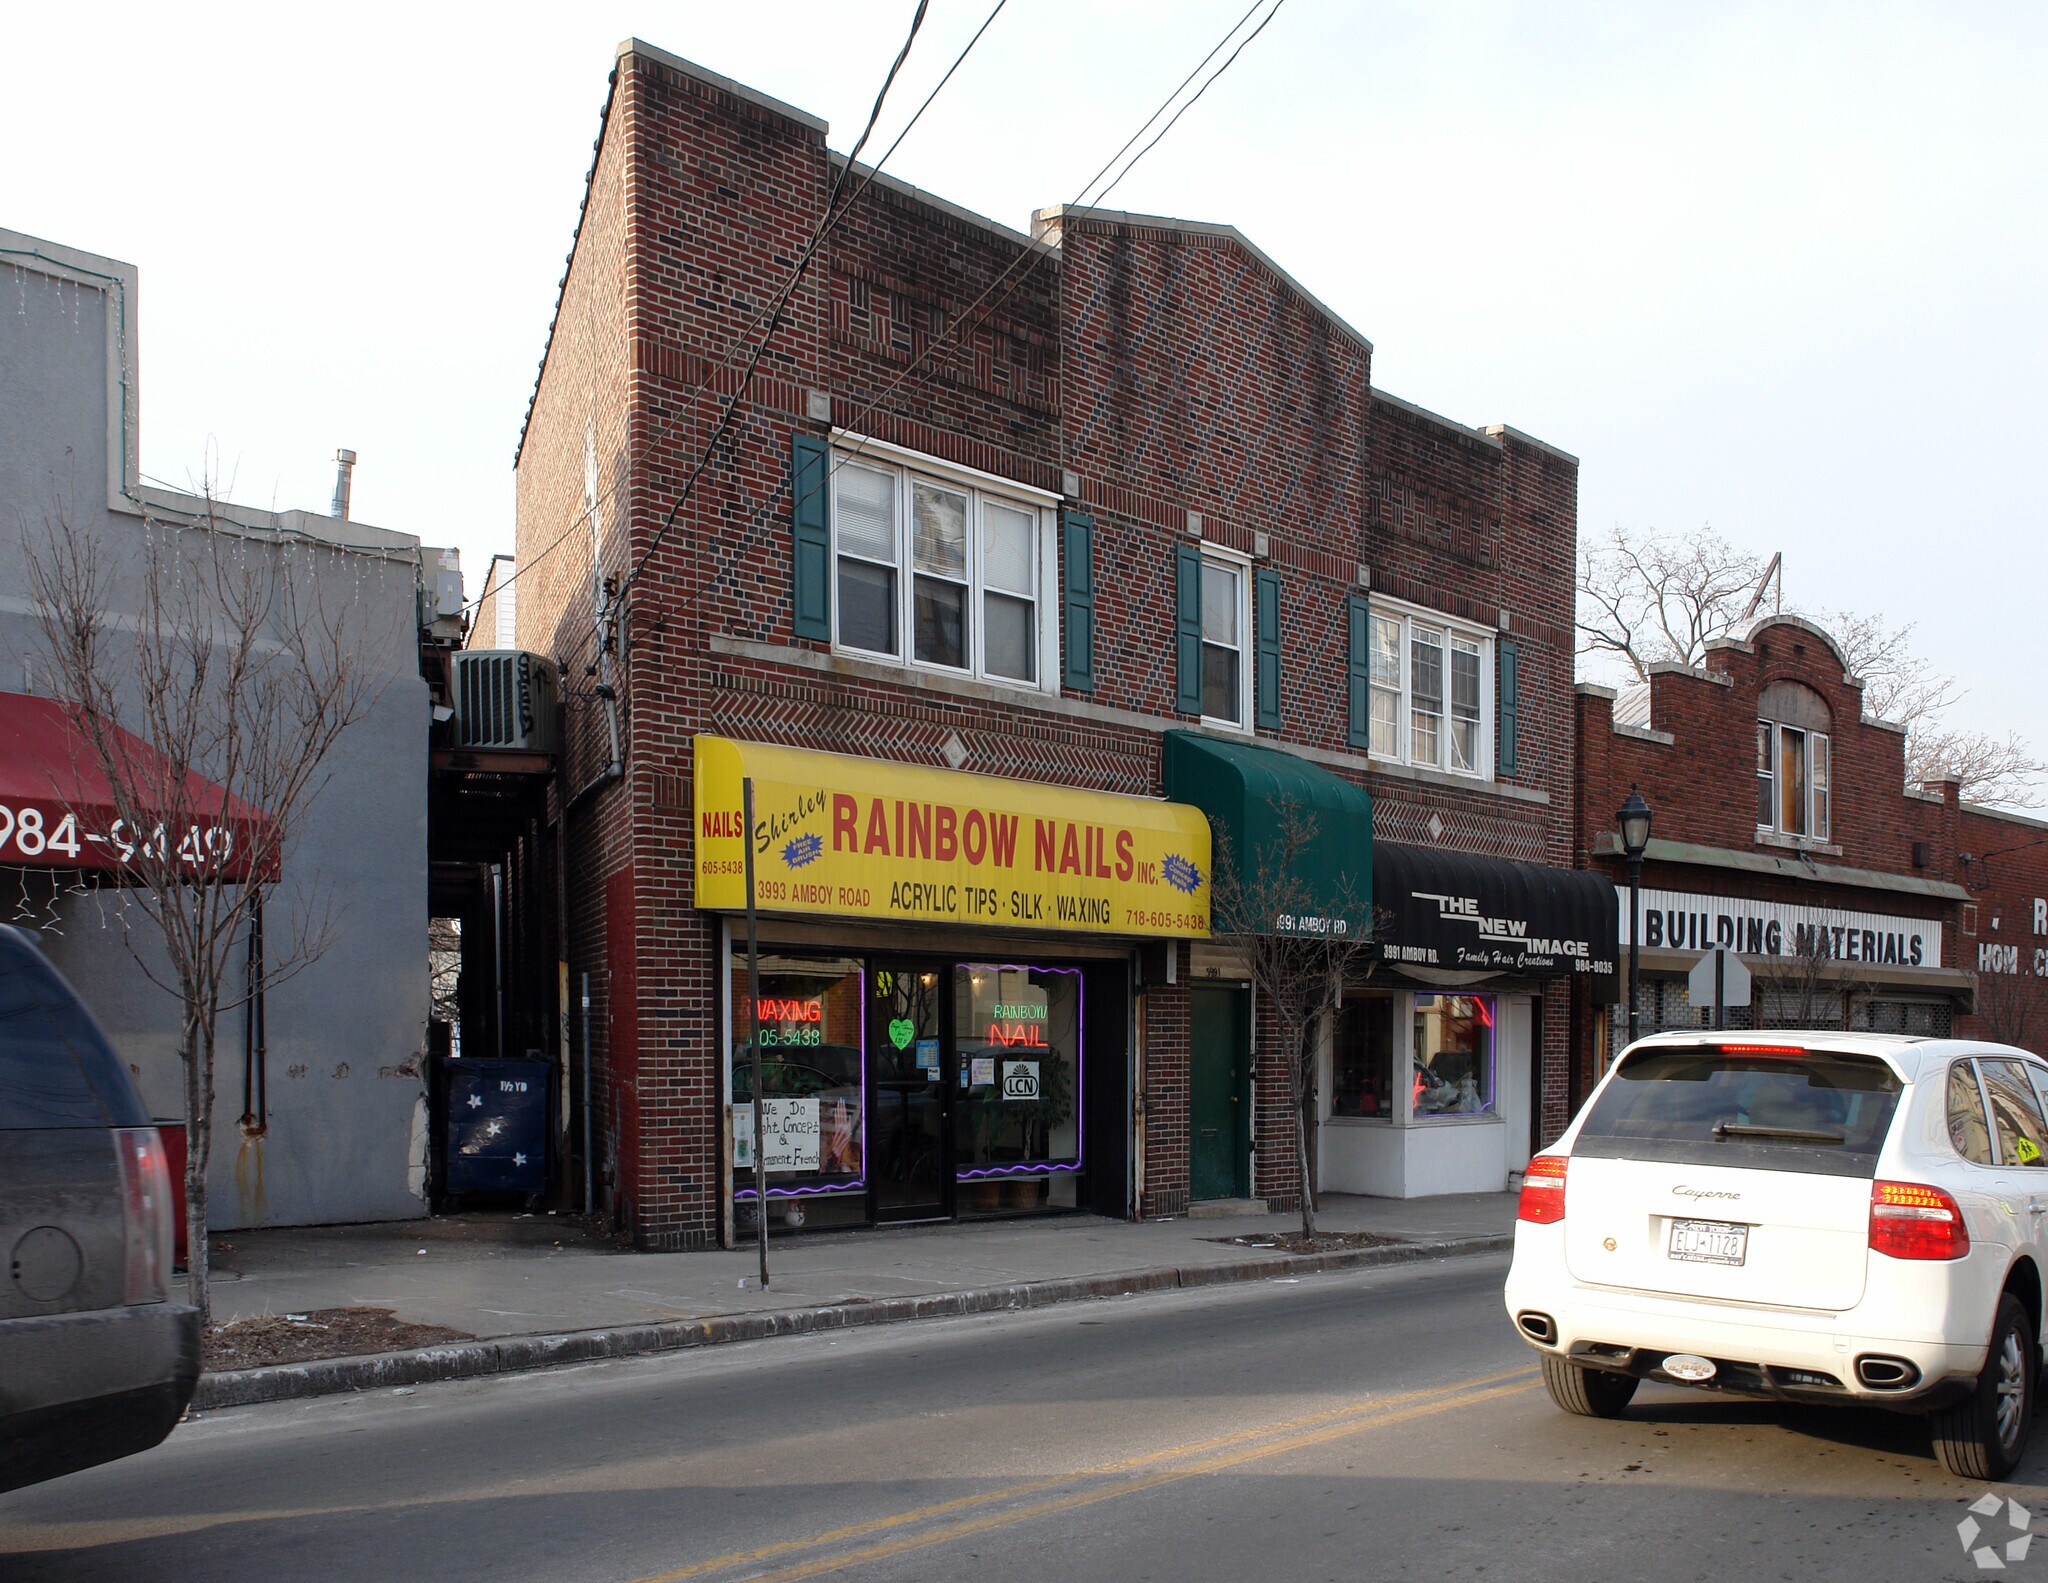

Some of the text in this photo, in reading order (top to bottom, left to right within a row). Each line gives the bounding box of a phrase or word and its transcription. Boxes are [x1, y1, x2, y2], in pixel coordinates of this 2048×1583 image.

[702, 811, 743, 838] NAILS
[755, 789, 826, 853] Shirley
[792, 839, 812, 849] FREE
[833, 793, 1158, 885] RAINBOW NAILS INC.
[798, 846, 810, 854] AIR
[702, 861, 743, 874] 605-5438
[1173, 860, 1191, 873] LIGHT
[758, 880, 870, 907] 3993 AMBOY ROAD
[890, 881, 1110, 924] ACRYLIC TIPS SILK WAXING
[1430, 893, 1479, 915] THE
[1126, 910, 1204, 930] 718-605-5438
[1299, 916, 1330, 933] AMBOY
[1475, 916, 1527, 937] NEW
[1646, 908, 1923, 966] BUILDING MATERIALS
[1383, 944, 1440, 964] 3991 AMBOY RD.
[1526, 938, 1589, 957] IMAGE
[1457, 947, 1554, 968] Family Hair Creations
[1575, 958, 1613, 974] 984-8035
[993, 1004, 1048, 1019] RAINBOW
[748, 1029, 820, 1046] 05-5438
[989, 1023, 1049, 1048] NAIL
[1008, 1078, 1034, 1094] LCN
[760, 1102, 778, 1115] We
[789, 1100, 806, 1115] Do
[783, 1115, 819, 1135] Concept
[778, 1133, 790, 1145] &
[1672, 1185, 1741, 1202] Cayenne
